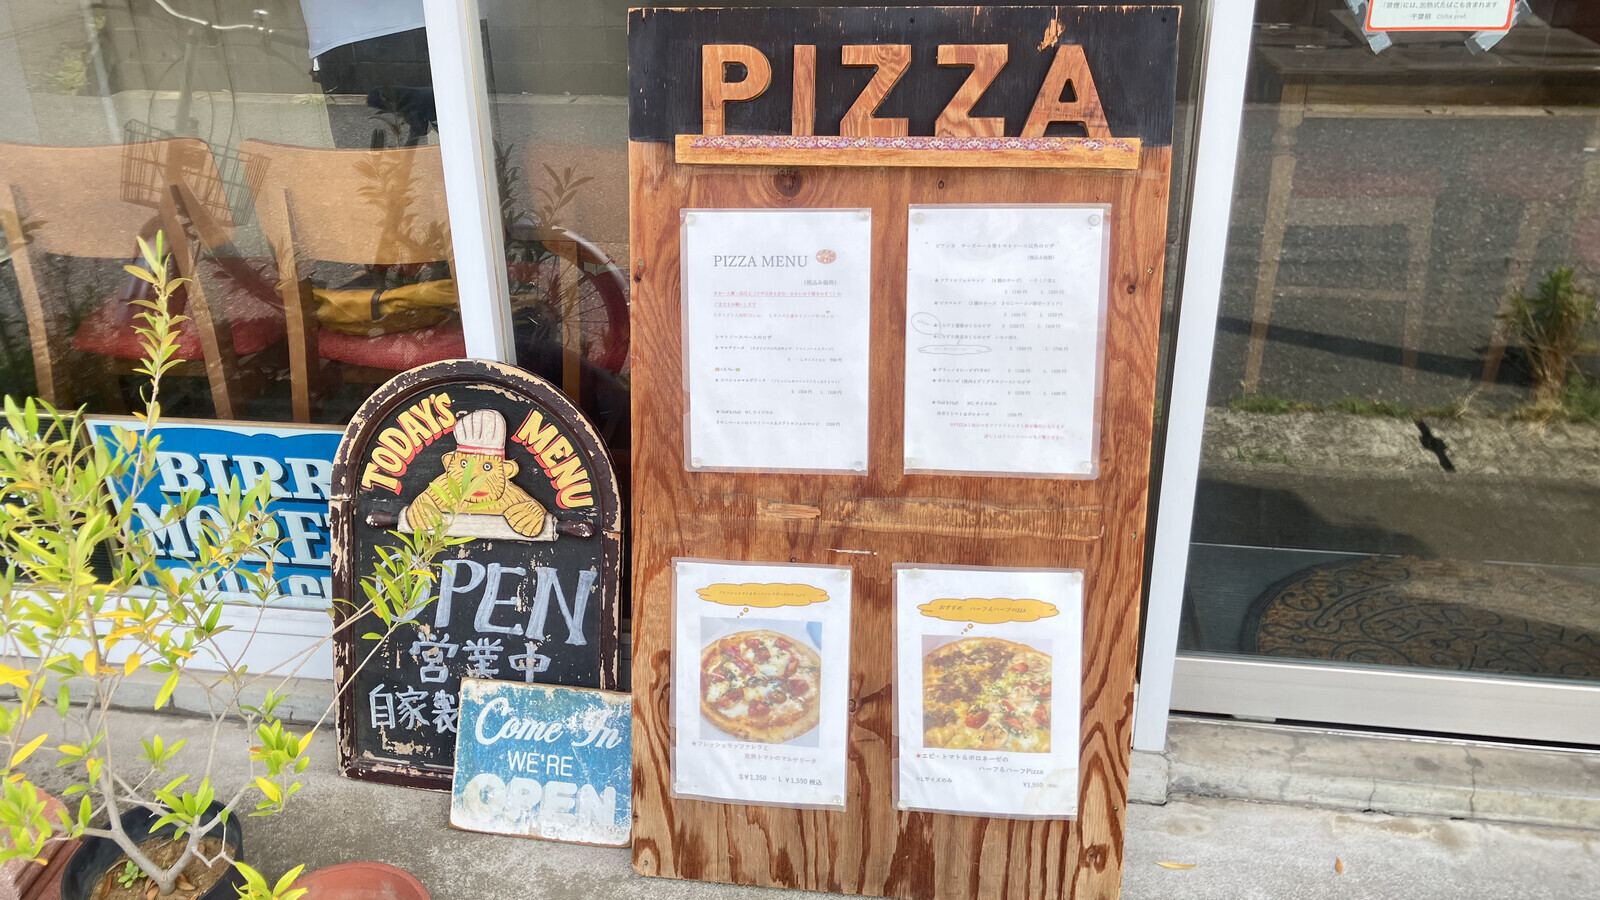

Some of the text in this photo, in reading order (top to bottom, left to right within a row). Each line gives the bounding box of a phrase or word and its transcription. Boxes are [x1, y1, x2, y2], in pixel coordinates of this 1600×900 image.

[701, 43, 1113, 138] PIZZA
[713, 255, 808, 268] PIZZA MENU
[361, 392, 594, 509] TODAY'S MENU
[132, 502, 333, 567] MORE
[409, 632, 551, 683] 営業中
[475, 697, 622, 750] Come In
[507, 750, 573, 777] WE'RE
[463, 773, 617, 827] OPEN
